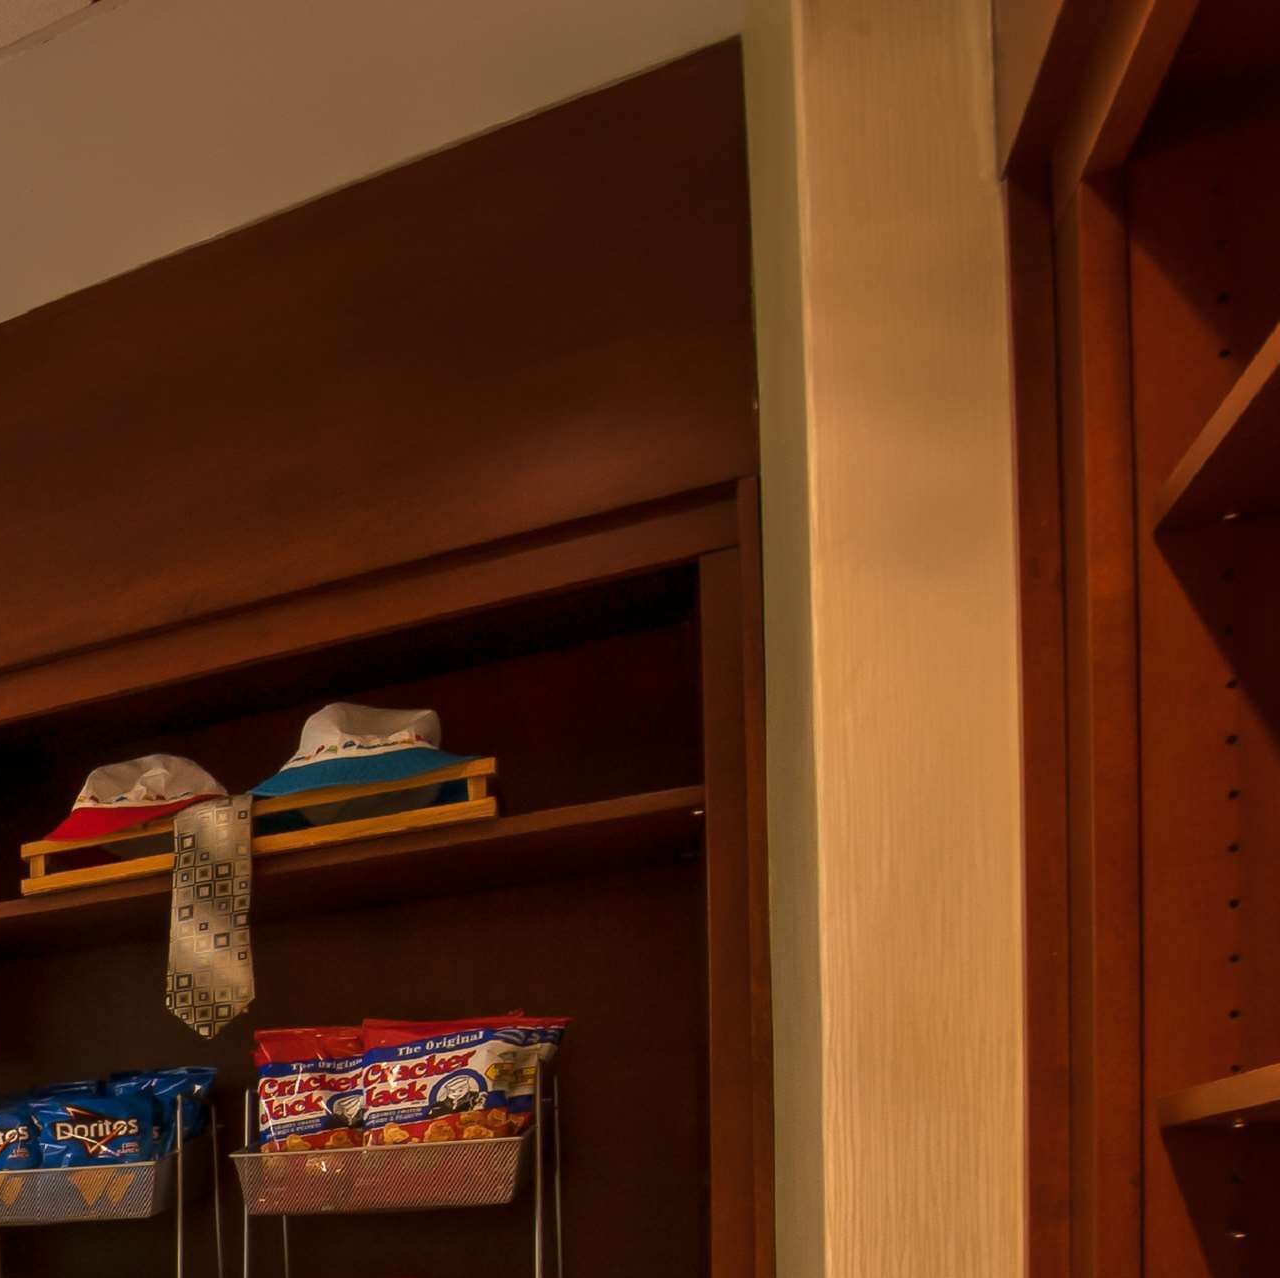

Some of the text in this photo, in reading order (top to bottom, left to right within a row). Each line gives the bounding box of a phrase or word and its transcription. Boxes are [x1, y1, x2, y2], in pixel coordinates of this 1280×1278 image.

[397, 1031, 485, 1057] The Original
[363, 1050, 477, 1088] Cracker
[258, 1073, 363, 1099] Cracker
[364, 1081, 428, 1108] Jack
[261, 1093, 325, 1125] Jack
[55, 1118, 139, 1141] Doritos
